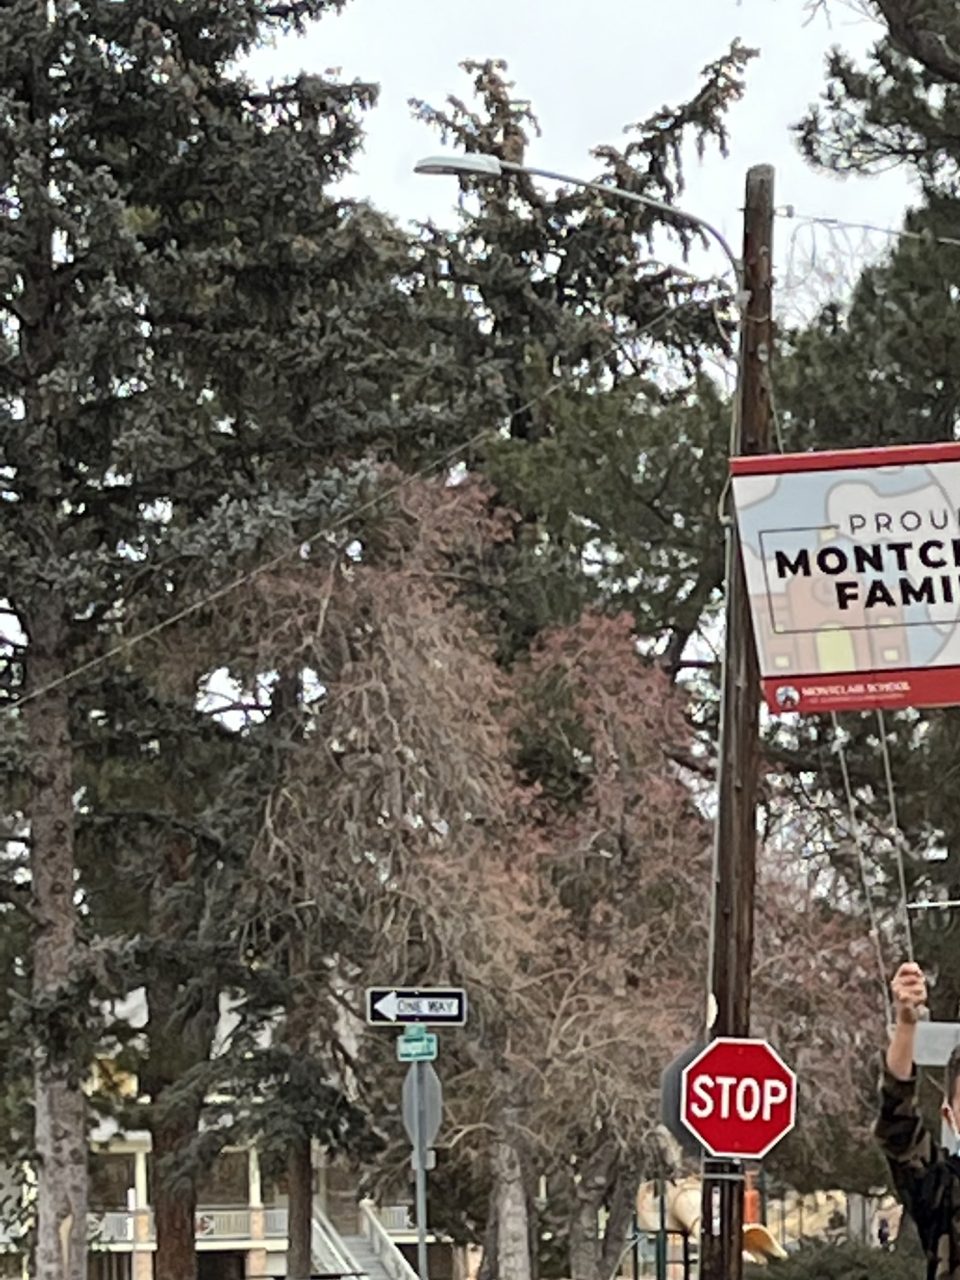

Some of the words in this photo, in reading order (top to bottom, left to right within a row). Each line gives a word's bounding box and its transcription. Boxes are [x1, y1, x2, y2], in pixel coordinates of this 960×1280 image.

[801, 684, 864, 696] MONTCLAIR
[398, 1000, 421, 1013] ONE
[427, 1001, 454, 1012] WAY
[691, 1074, 787, 1120] STOP
